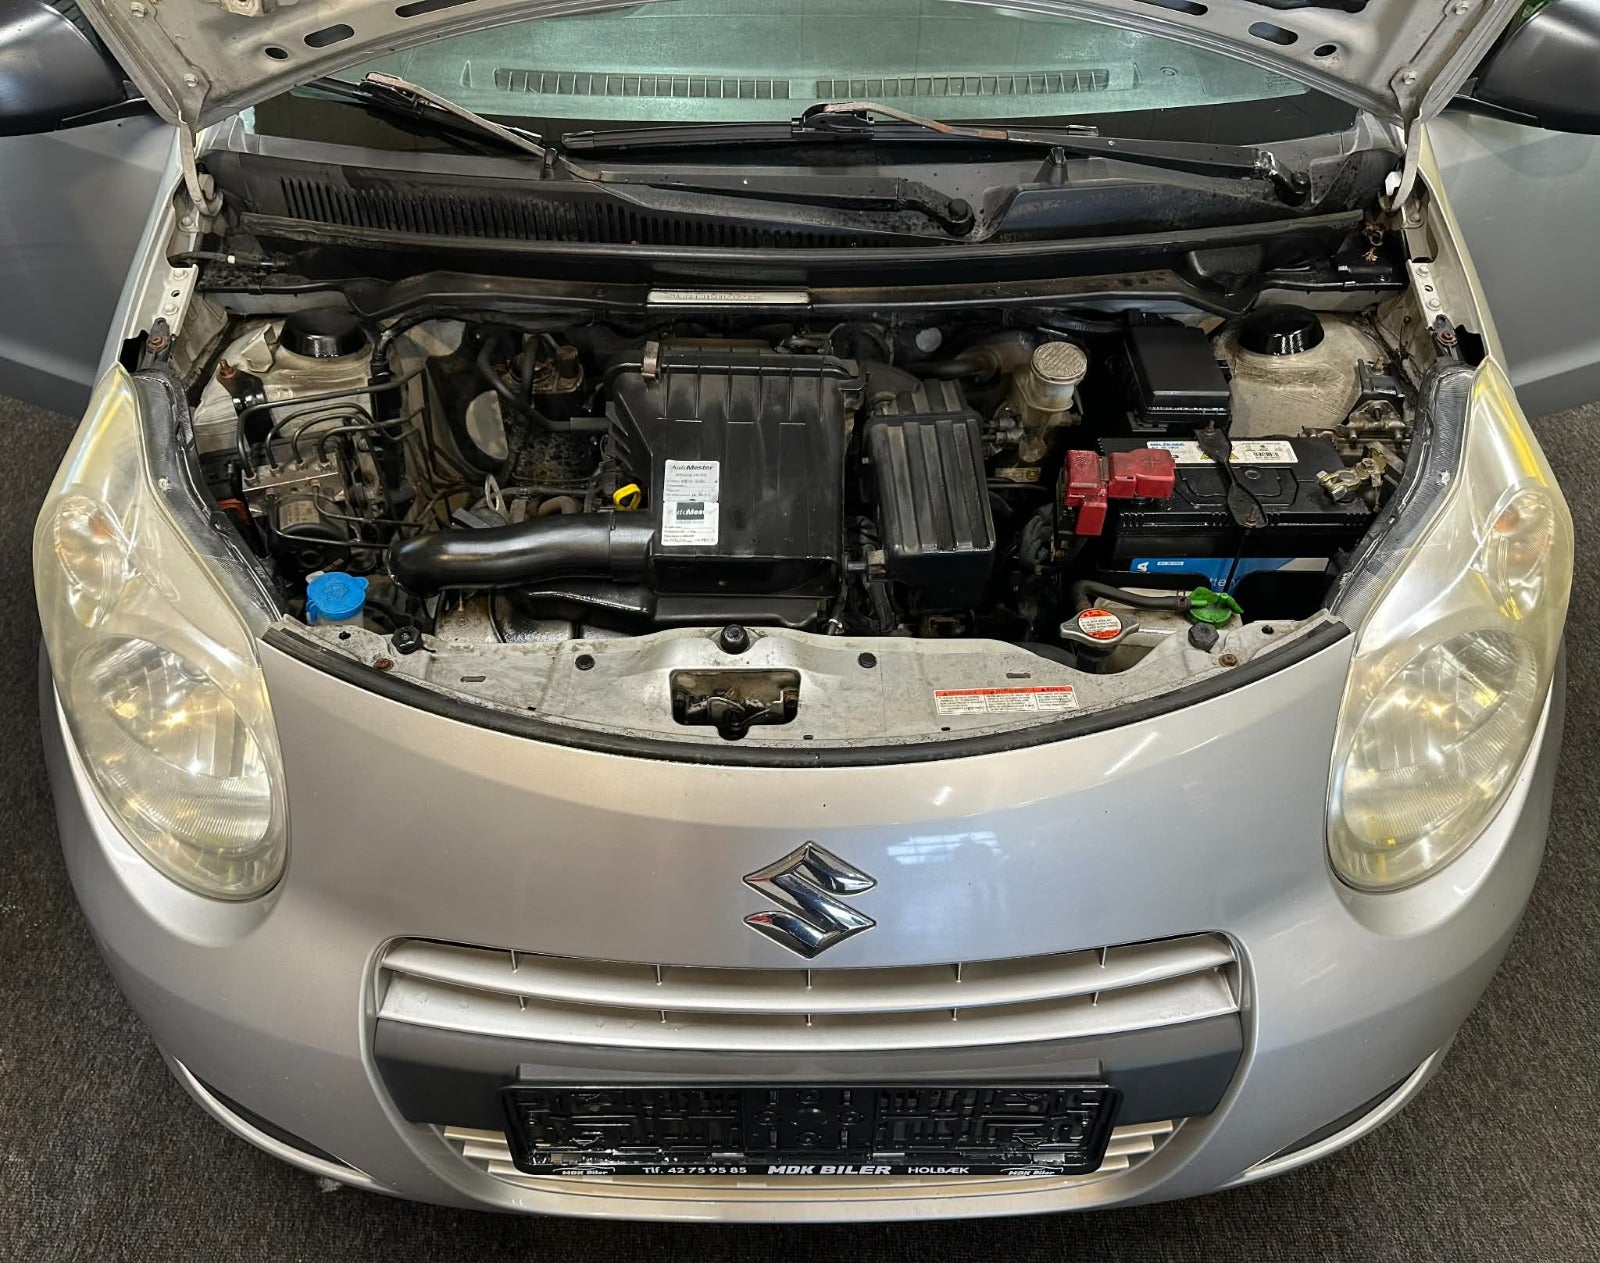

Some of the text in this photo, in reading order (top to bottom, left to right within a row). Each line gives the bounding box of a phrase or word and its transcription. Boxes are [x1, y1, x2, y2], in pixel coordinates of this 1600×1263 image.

[642, 1166, 748, 1174] Tlf. 42 75 95 85
[767, 1165, 892, 1175] MDK BILER
[907, 1166, 970, 1174] HOLBÆK
